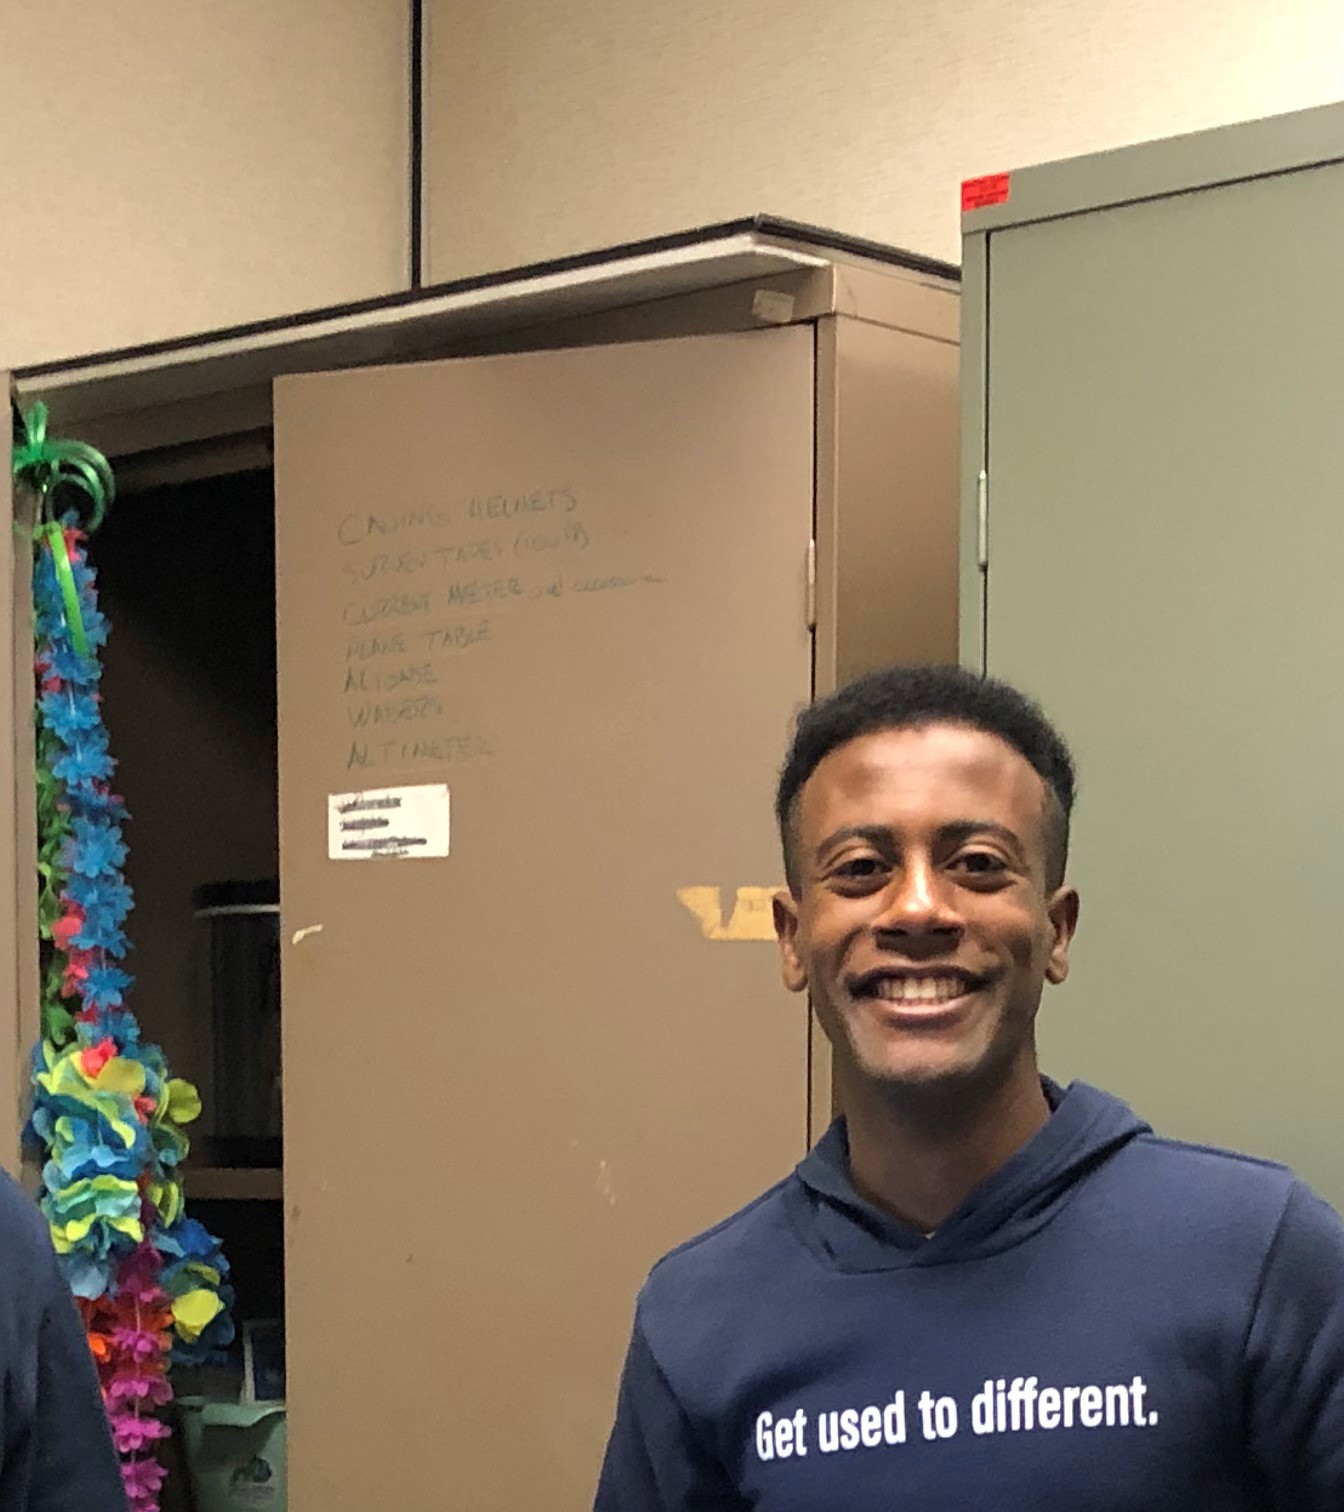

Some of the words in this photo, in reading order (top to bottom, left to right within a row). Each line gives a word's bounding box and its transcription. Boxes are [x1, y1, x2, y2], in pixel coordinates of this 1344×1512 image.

[469, 487, 578, 521] HELMETS
[448, 577, 521, 604] METER
[425, 619, 492, 650] TABLE
[755, 1407, 808, 1462] Get
[818, 1389, 907, 1454] used
[917, 1389, 957, 1440] to
[971, 1375, 1159, 1436] different.
